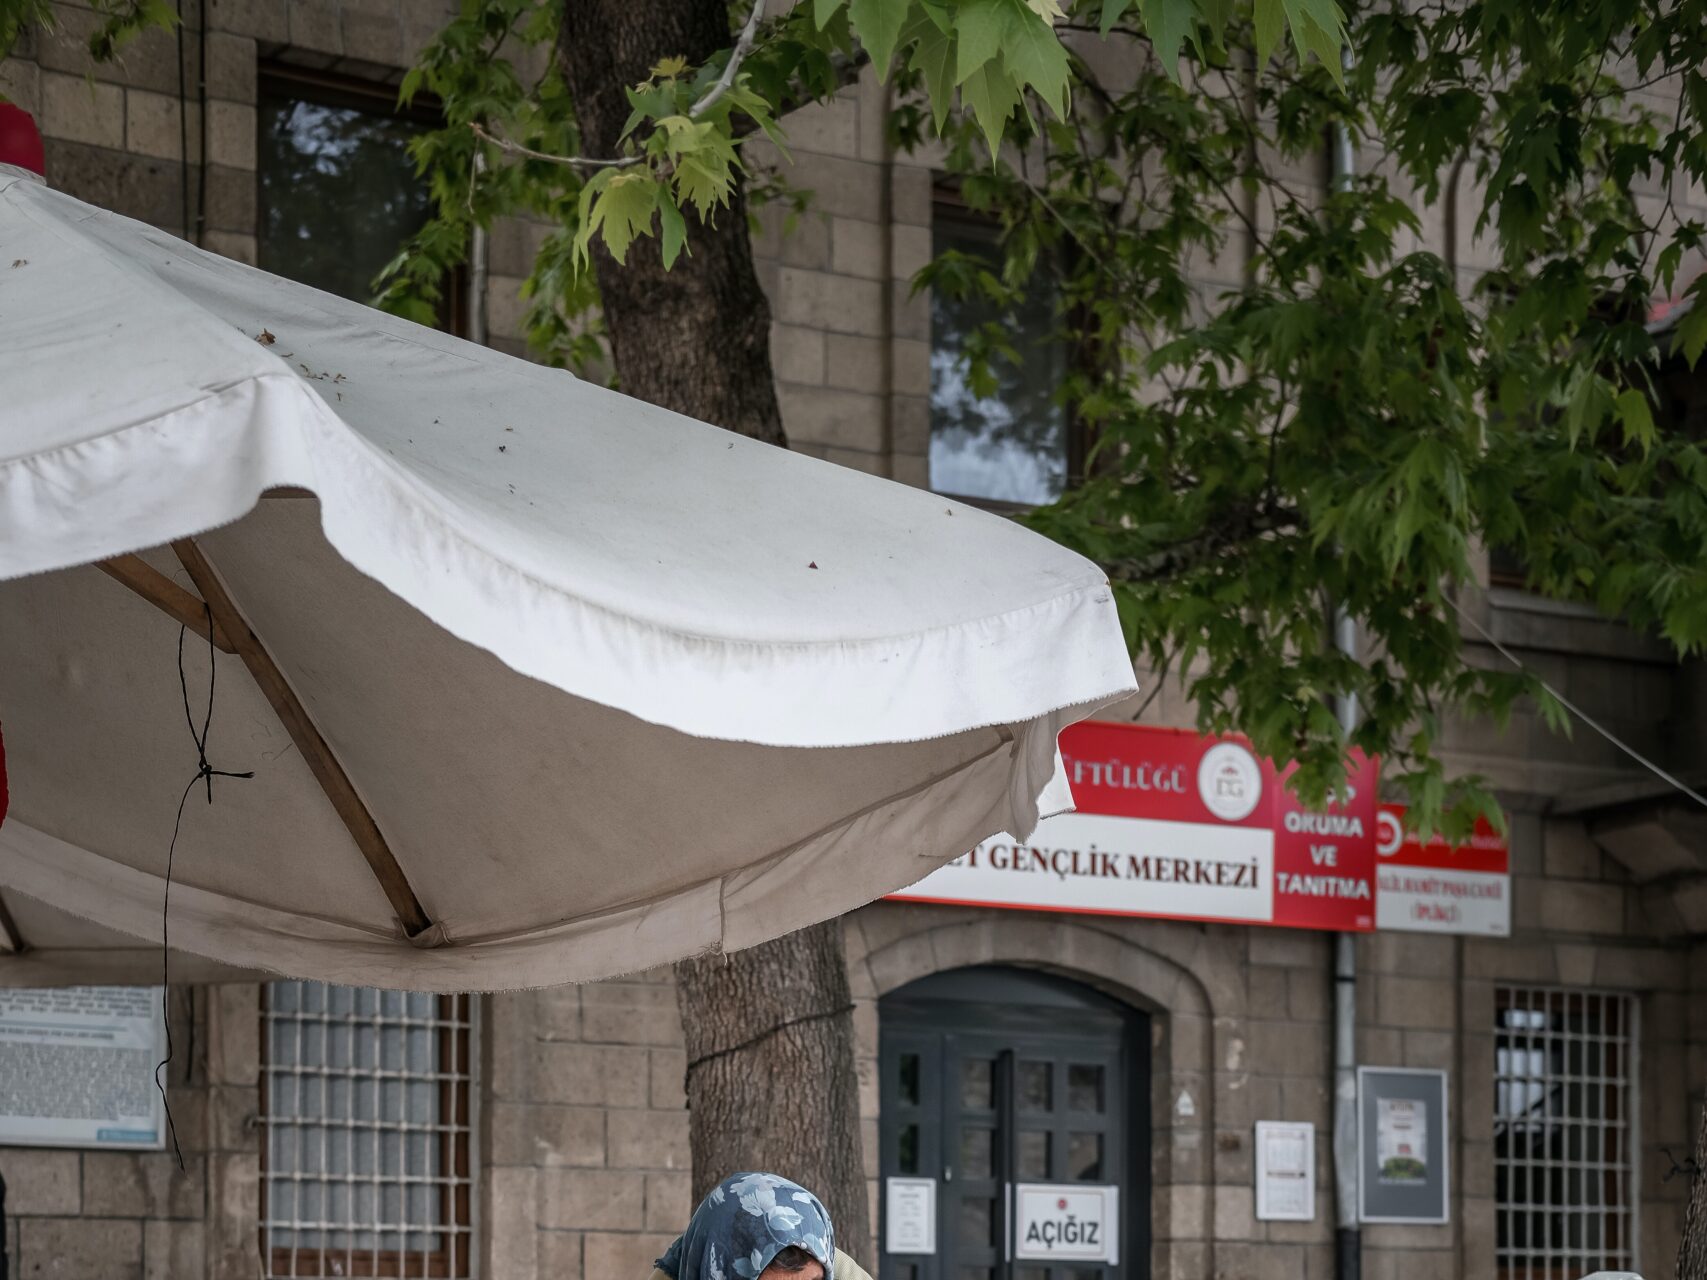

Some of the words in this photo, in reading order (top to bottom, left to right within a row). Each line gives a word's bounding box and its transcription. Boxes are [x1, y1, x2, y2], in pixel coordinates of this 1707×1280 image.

[1064, 753, 1186, 793] FTÜLÜĞÜ
[1284, 811, 1363, 838] OKUMA
[989, 844, 1121, 881] GENÇLİK
[1126, 856, 1259, 889] MERKEZİ
[1310, 844, 1338, 867] VE
[1276, 871, 1371, 900] TANITMA
[1025, 1215, 1100, 1248] AÇIĞIZ
